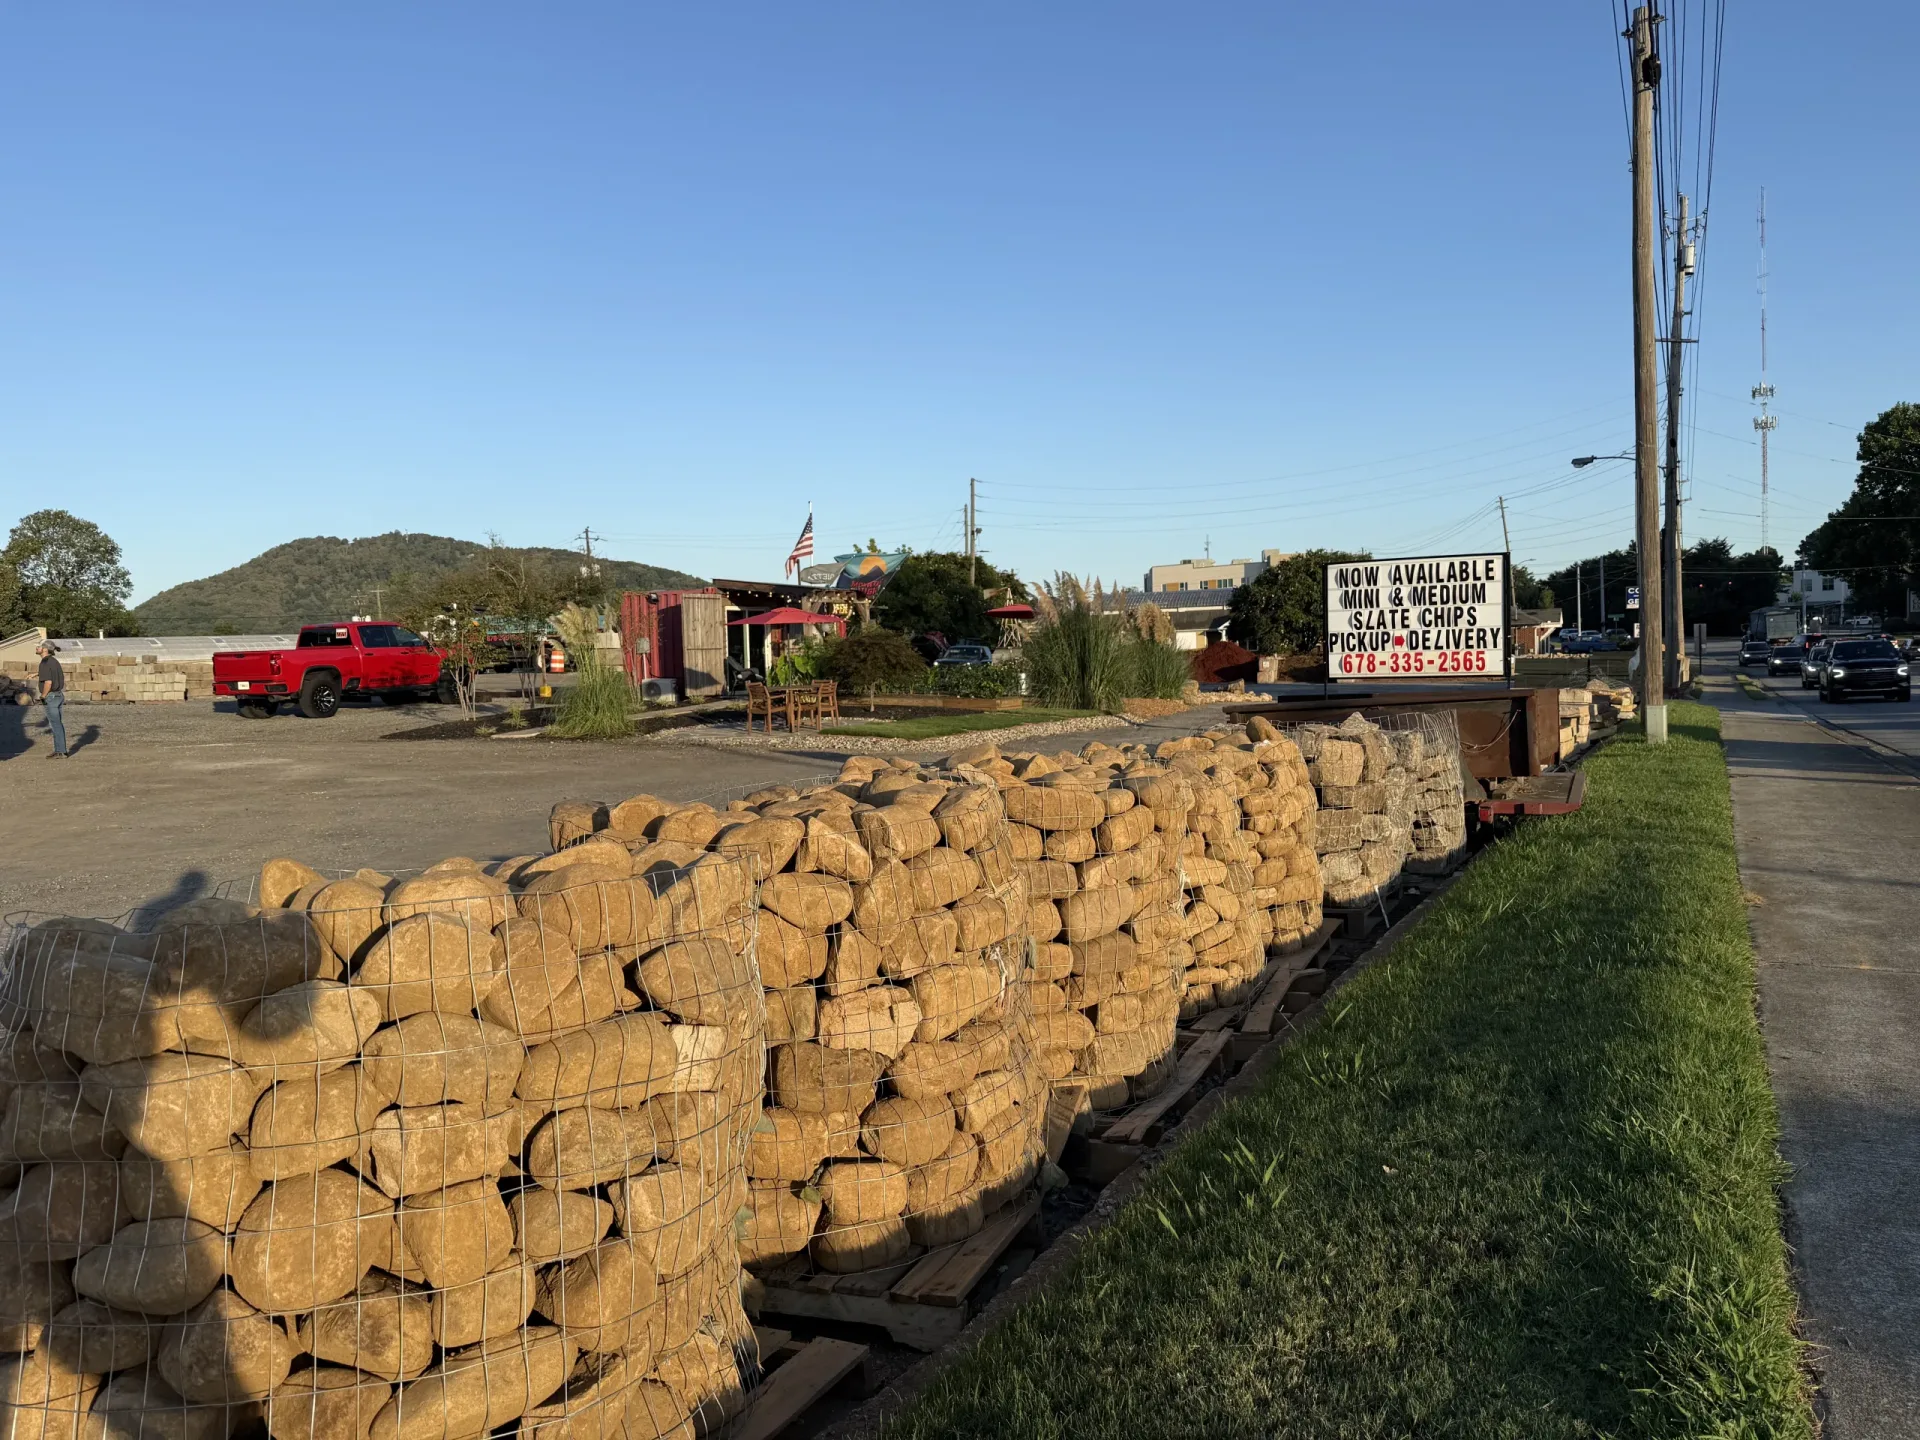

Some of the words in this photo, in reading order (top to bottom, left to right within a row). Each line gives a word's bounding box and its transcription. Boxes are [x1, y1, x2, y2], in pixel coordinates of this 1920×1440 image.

[1338, 566, 1380, 588] NOW
[1392, 559, 1495, 586] AVAILABLE
[1343, 588, 1380, 610] MINI
[1392, 587, 1404, 607] &
[1412, 583, 1487, 607] MEDIUM
[1353, 608, 1410, 631] SLATE
[1421, 606, 1477, 628] CHIPS
[1329, 631, 1391, 653] PICKUP
[1409, 627, 1501, 651] DELIVERY
[1343, 650, 1486, 674] 678-335-2565
